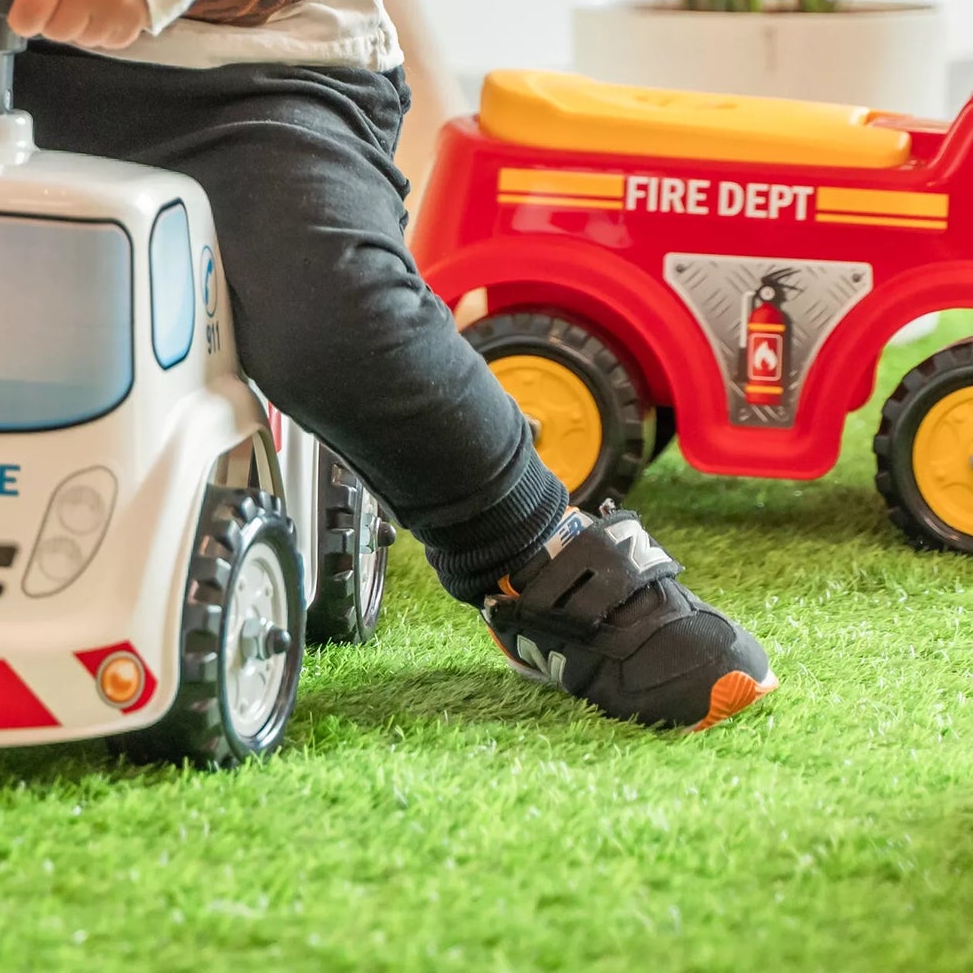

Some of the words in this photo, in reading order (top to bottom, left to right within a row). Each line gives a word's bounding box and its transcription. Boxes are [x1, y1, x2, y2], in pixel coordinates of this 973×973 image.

[626, 175, 711, 215] FIRE
[717, 181, 815, 221] DEPT
[206, 321, 221, 355] 911
